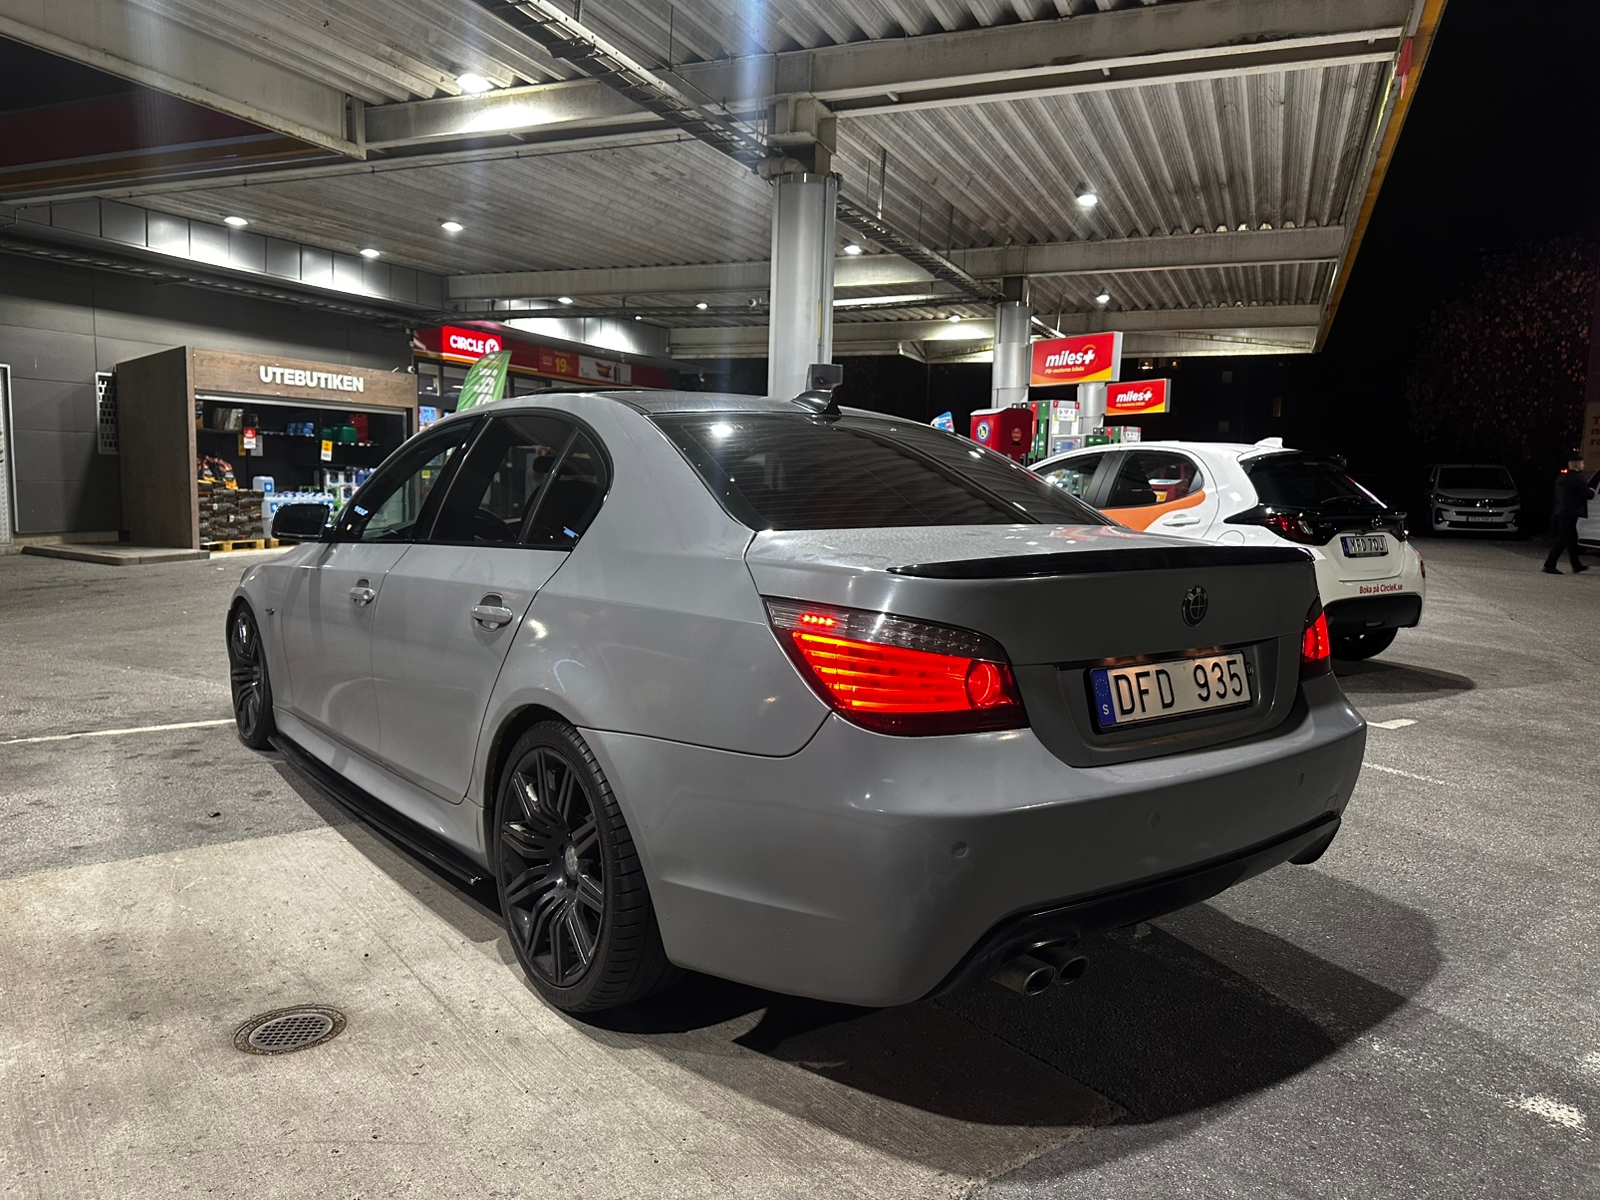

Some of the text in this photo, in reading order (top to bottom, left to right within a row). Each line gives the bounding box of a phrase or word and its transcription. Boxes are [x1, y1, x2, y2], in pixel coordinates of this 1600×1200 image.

[449, 334, 484, 353] CIRCLE
[1045, 349, 1095, 367] miles+
[259, 365, 364, 392] UTEBUTIKEN
[1116, 390, 1152, 402] miles+
[1359, 583, 1403, 594] Boka på CircleK.se
[1113, 659, 1243, 716] DFD 935
[1102, 704, 1110, 715] S
